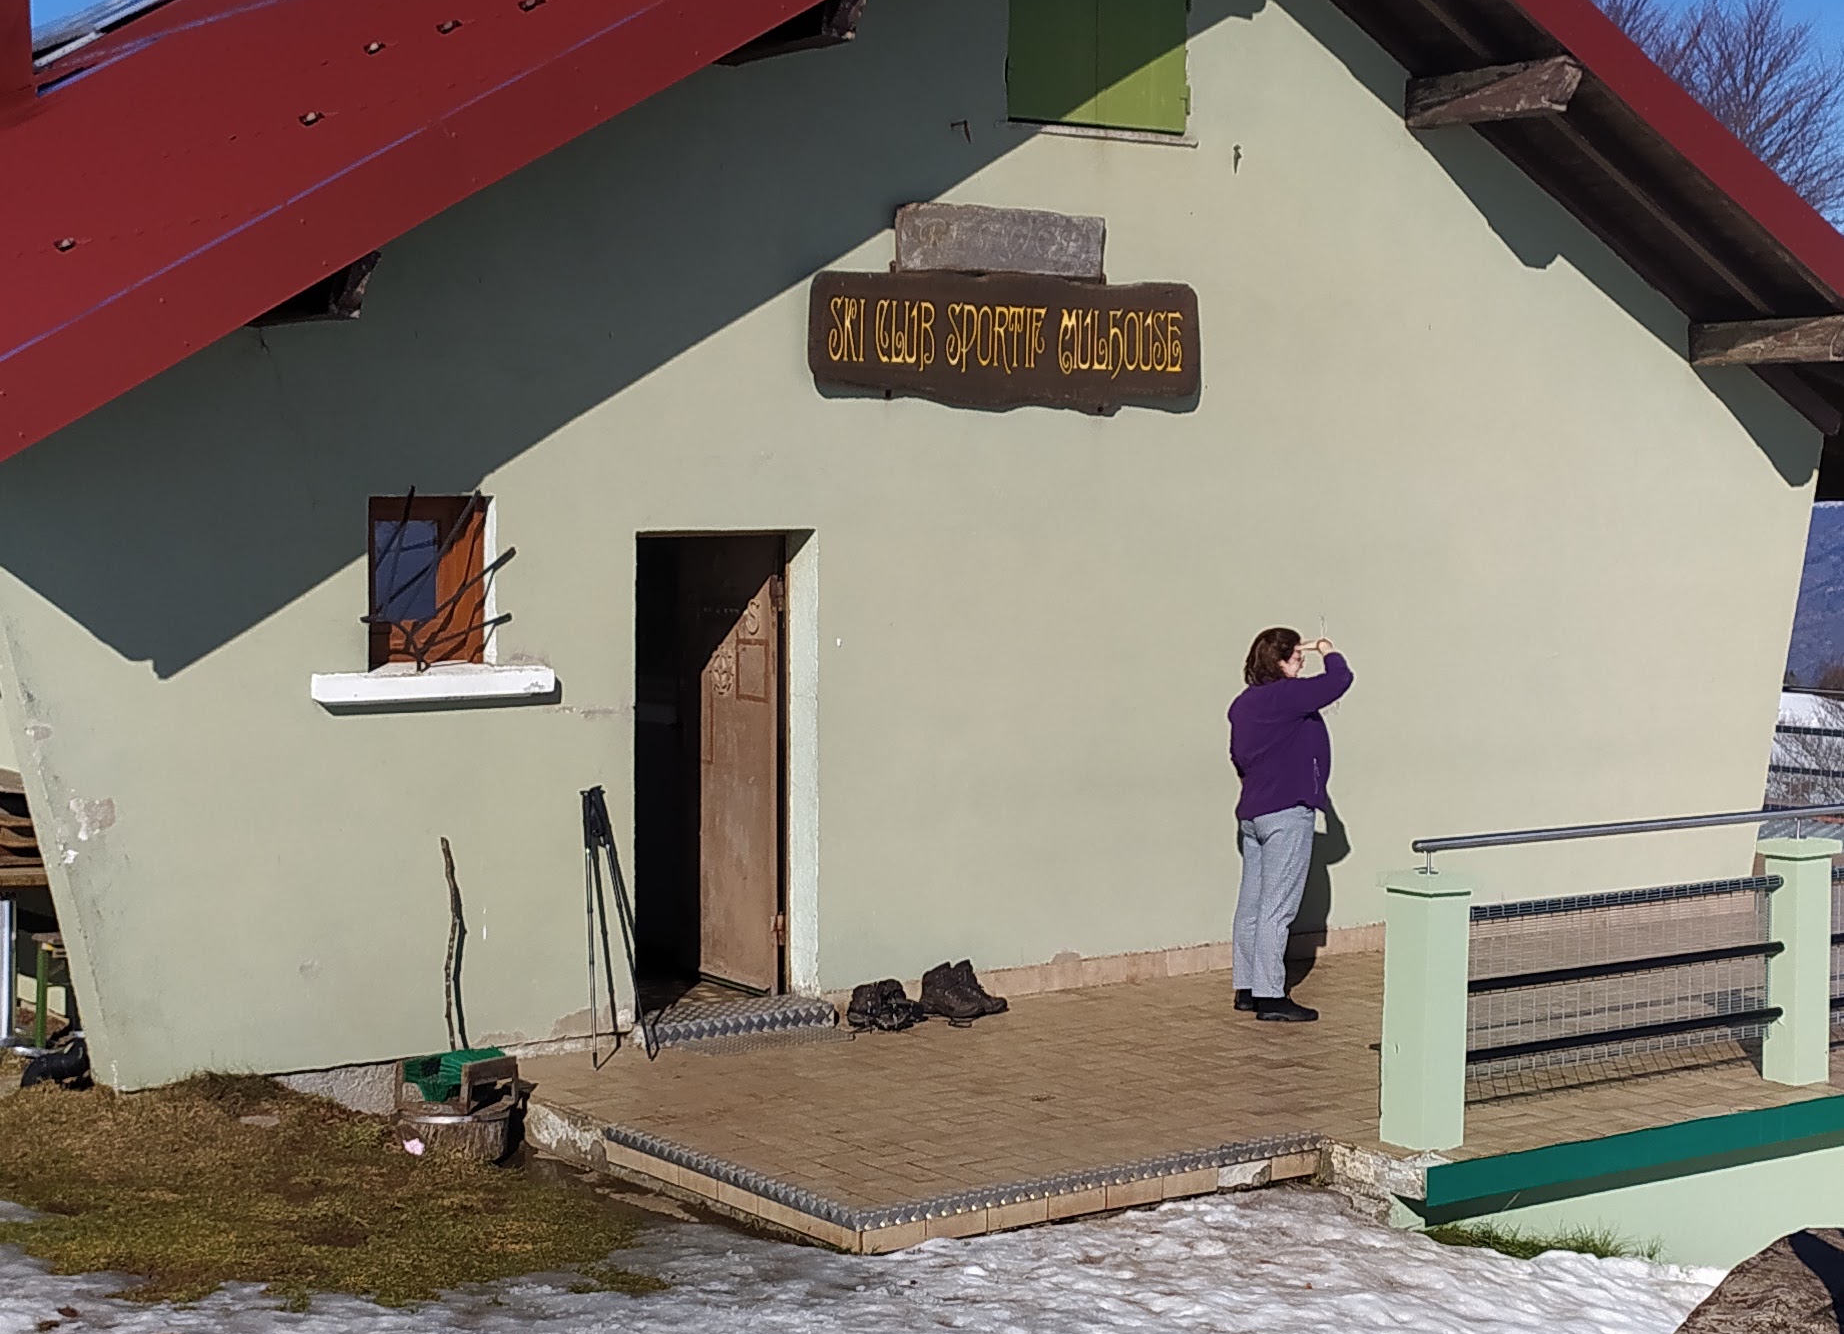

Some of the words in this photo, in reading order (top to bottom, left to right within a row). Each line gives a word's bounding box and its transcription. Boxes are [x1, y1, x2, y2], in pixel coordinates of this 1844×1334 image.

[828, 295, 866, 362] SKI
[875, 298, 936, 372] CLUB
[945, 302, 1048, 375] SPORTIF
[1057, 307, 1184, 380] MULHOUSE
